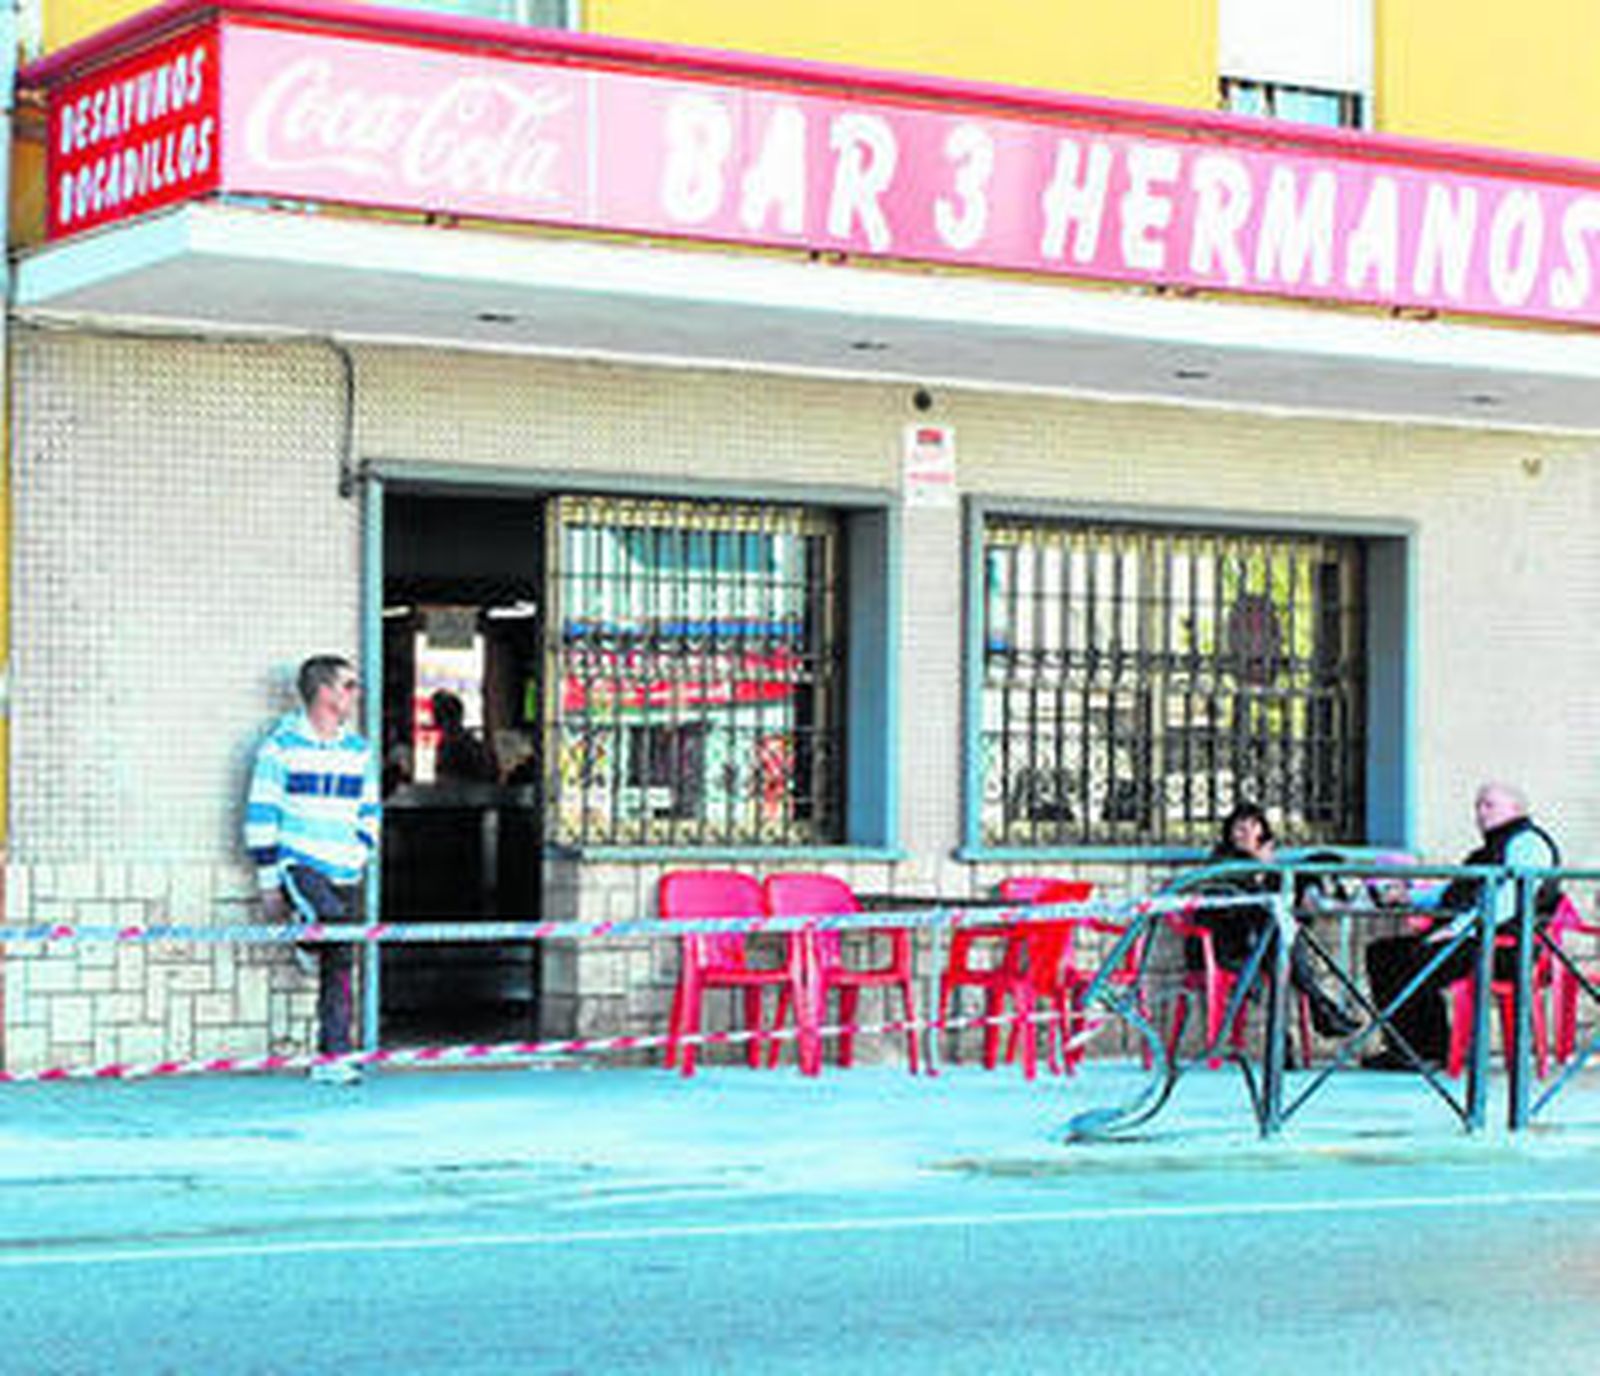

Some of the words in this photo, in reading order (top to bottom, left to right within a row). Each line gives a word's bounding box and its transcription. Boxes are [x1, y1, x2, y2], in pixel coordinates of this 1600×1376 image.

[60, 115, 213, 225] BOCADILLOS
[661, 94, 898, 252] BAR
[934, 121, 995, 251] 3
[1040, 138, 1600, 308] HERMANOS
